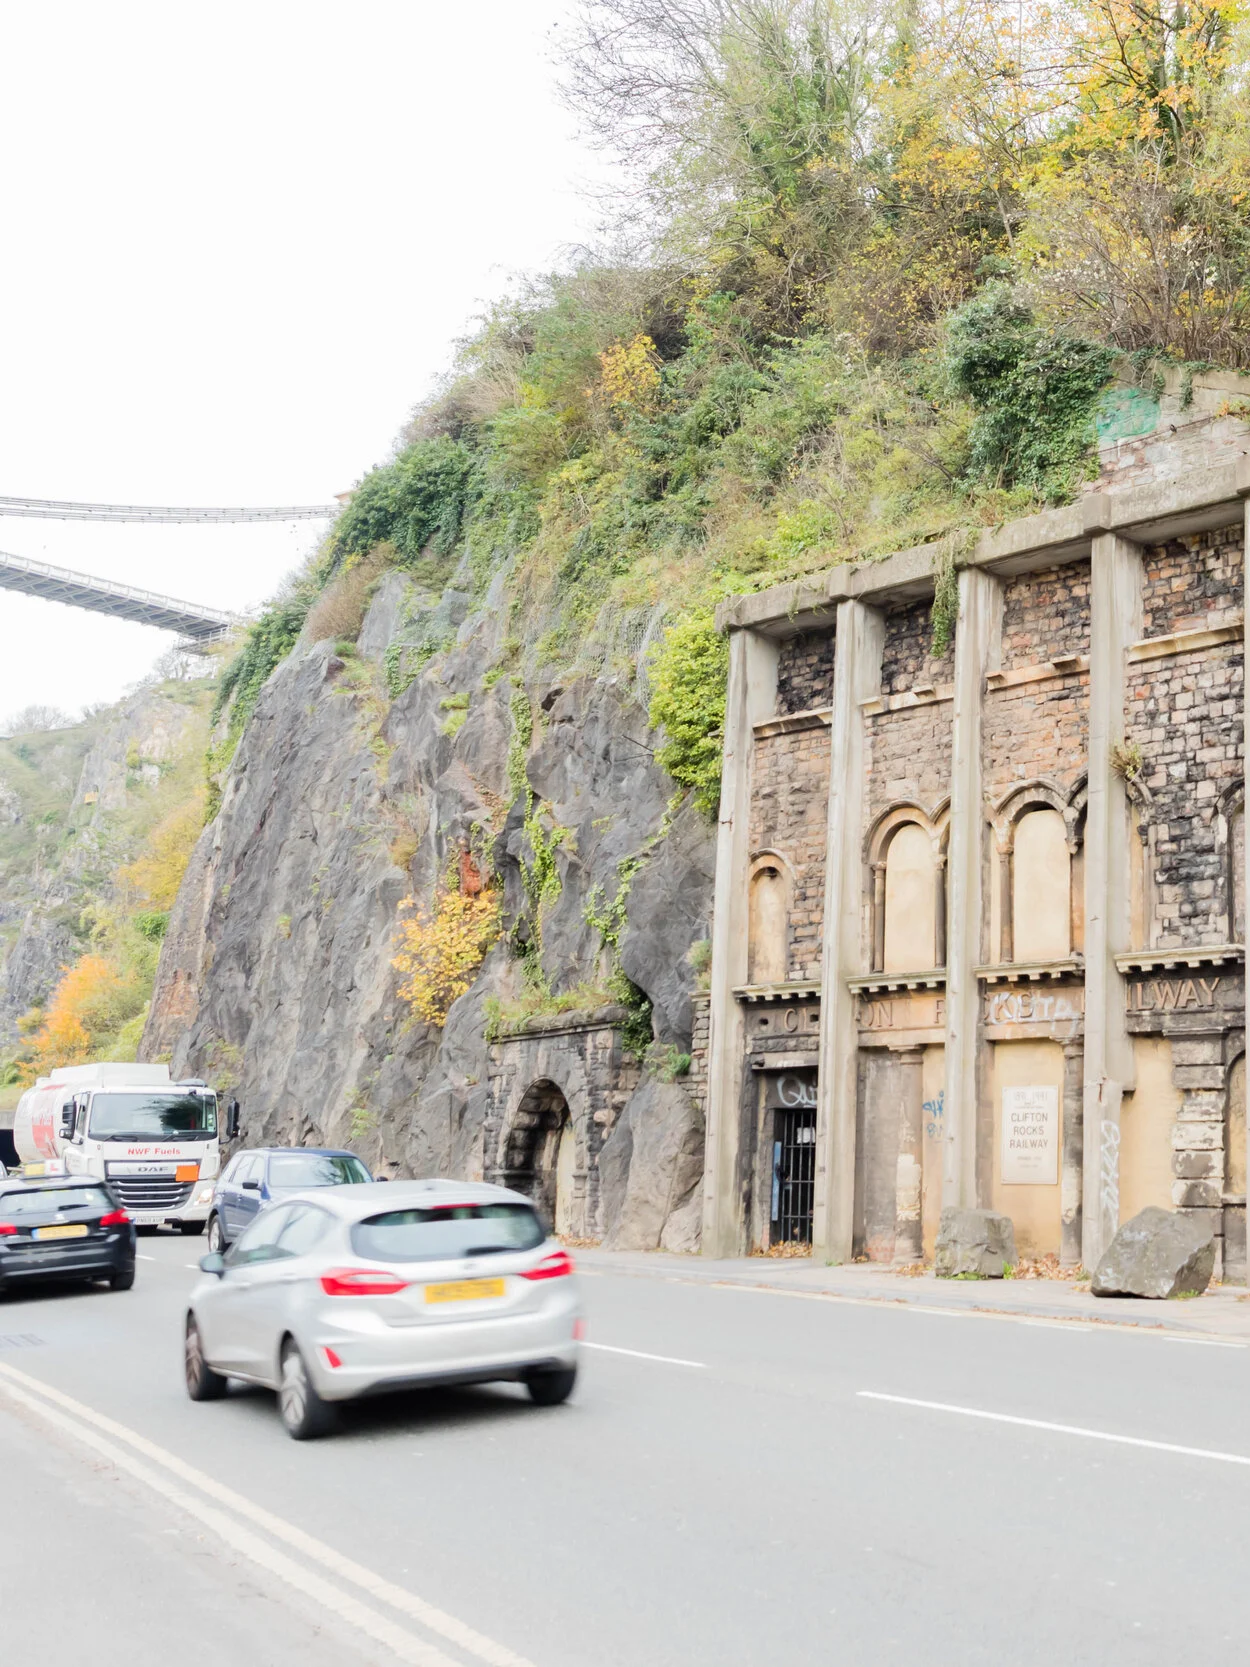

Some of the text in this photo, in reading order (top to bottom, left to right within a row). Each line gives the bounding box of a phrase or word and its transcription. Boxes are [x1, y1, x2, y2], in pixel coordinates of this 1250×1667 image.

[1011, 1112, 1048, 1122] CLIFTON
[1013, 1126, 1044, 1136] ROCKS
[1009, 1139, 1048, 1149] RAILWAY
